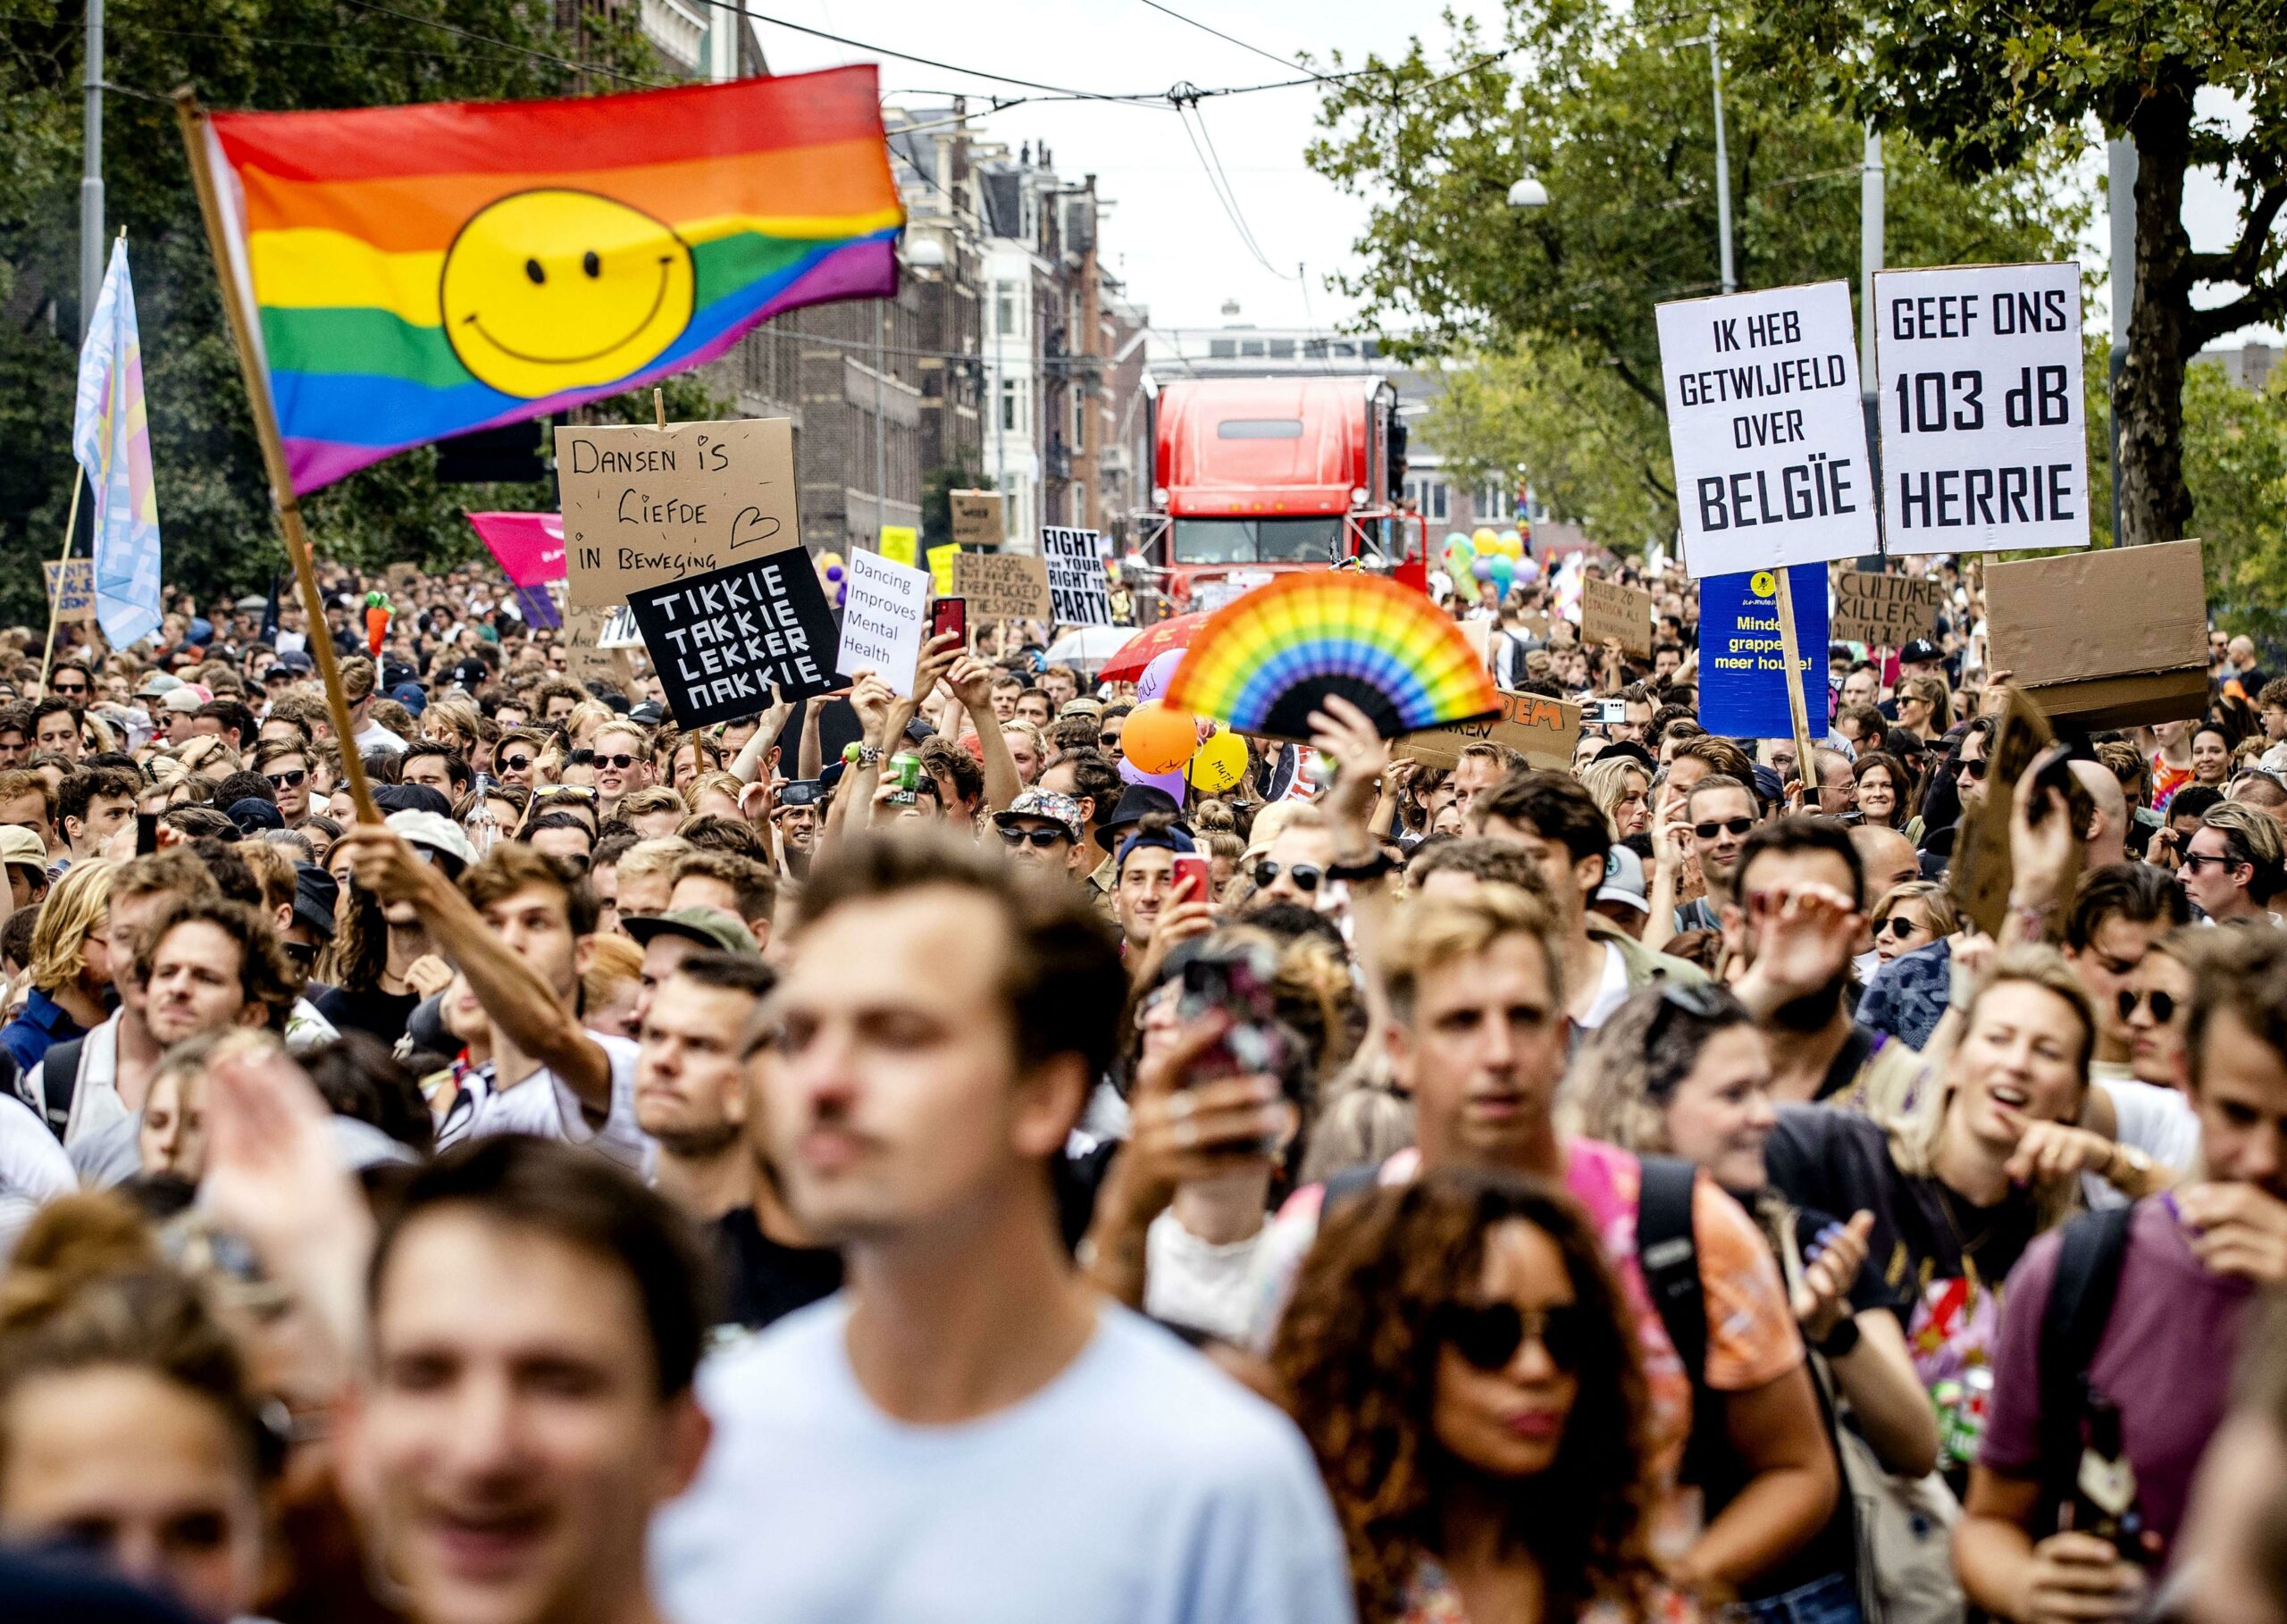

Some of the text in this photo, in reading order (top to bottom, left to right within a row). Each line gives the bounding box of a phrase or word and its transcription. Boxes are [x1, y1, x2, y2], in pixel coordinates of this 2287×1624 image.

[1713, 310, 1801, 353] IK HEB
[1892, 289, 2066, 340] GEEF ONS
[1680, 355, 1846, 406] GETWIJFELD
[1896, 364, 2069, 434] 103 dB
[1733, 409, 1805, 449] OVER
[1697, 452, 1856, 532] BELGÏE
[1900, 464, 2074, 529] HERRIE
[1043, 529, 1097, 558] FIGHT
[854, 559, 911, 596] Dancing
[1049, 569, 1105, 590] RIGHT TO
[1064, 557, 1102, 572] YOUR
[651, 565, 786, 622] TIKKIE
[850, 584, 917, 621] Improves
[993, 582, 1043, 600] FUCKED
[1051, 589, 1108, 624] PARTY
[1840, 573, 1942, 606] CULTURE
[665, 599, 799, 655] TAKKIE
[847, 610, 899, 640] Mental
[1737, 616, 1781, 632] Minde
[1837, 597, 1923, 626] KILLER
[677, 626, 810, 682] LEKKER
[844, 635, 891, 665] Health
[1715, 656, 1813, 671] meer houe!
[1729, 638, 1783, 654] grappe
[1211, 759, 1234, 783] MUTE
